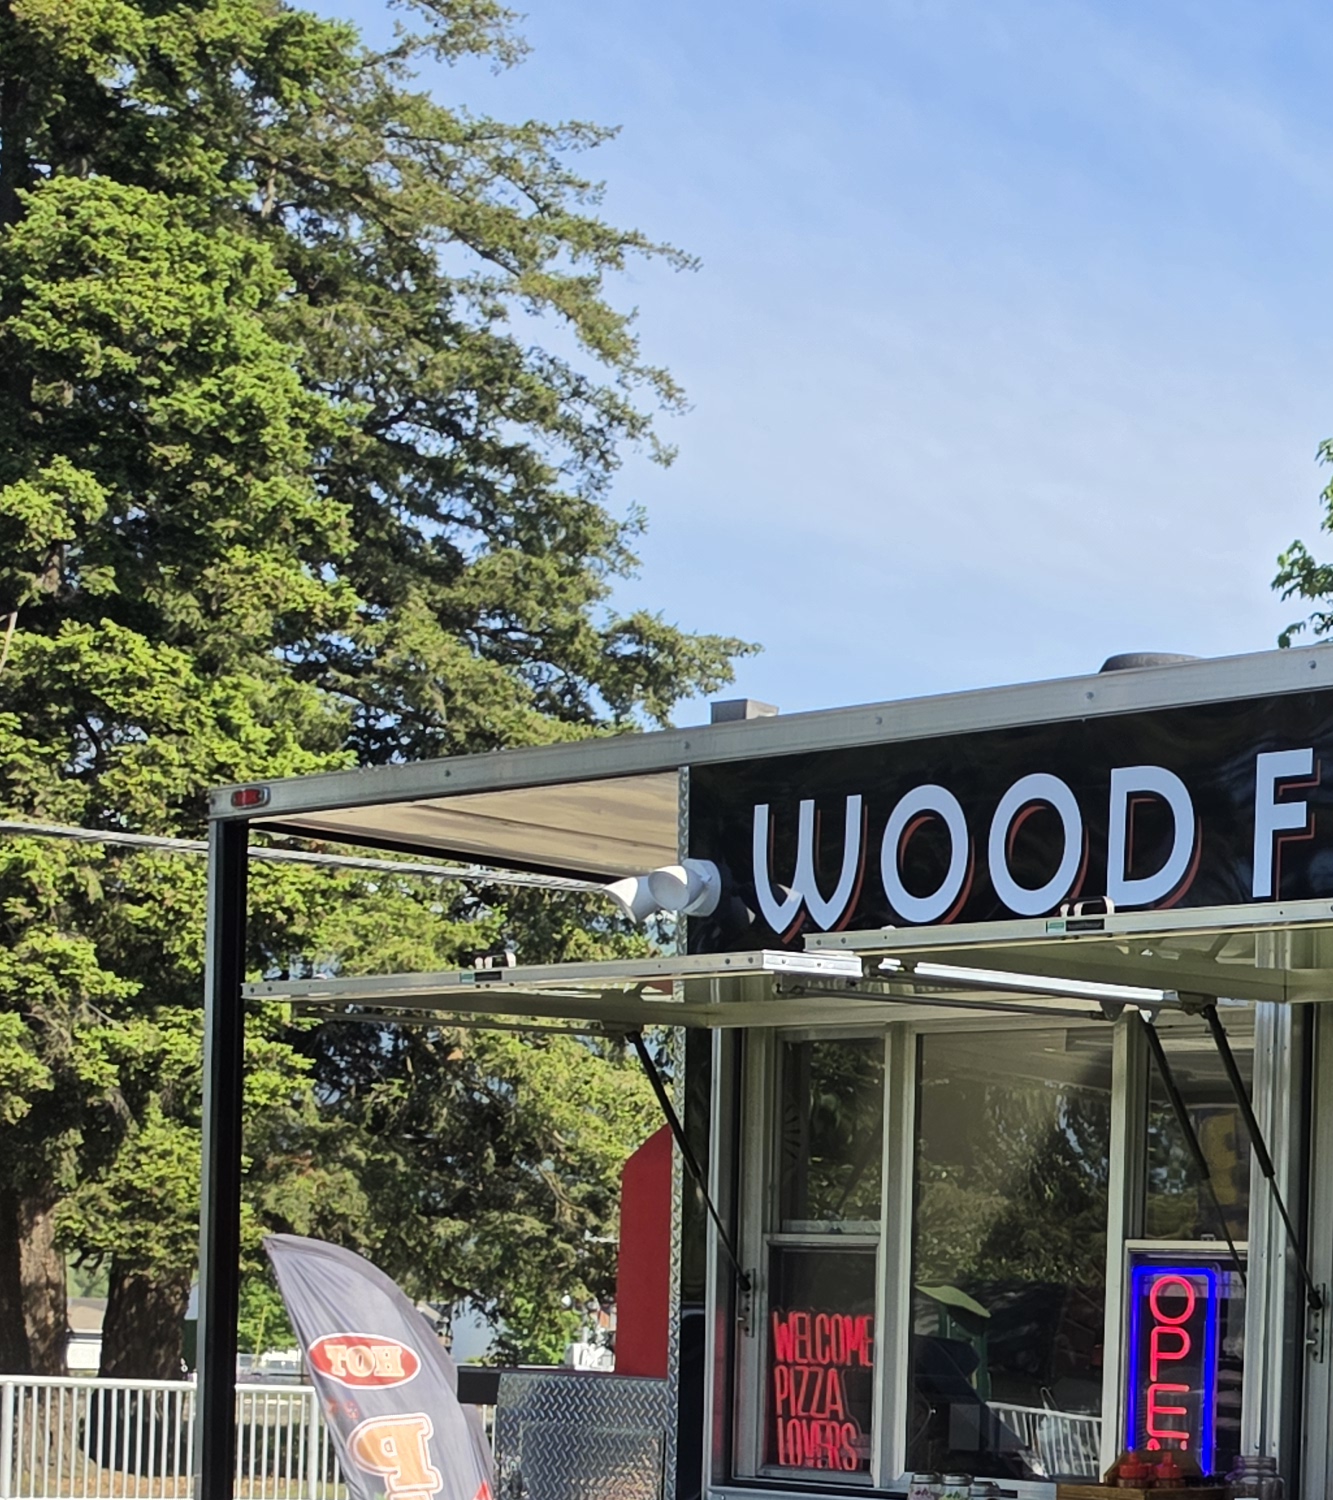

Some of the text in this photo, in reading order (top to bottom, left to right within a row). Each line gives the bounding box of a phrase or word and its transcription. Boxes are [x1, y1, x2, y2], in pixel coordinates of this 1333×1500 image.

[752, 764, 1202, 938] WOOD
[771, 1311, 875, 1367] WELCOME
[1146, 1274, 1197, 1452] OPE
[774, 1365, 846, 1420] PIZZA
[776, 1416, 860, 1472] LOVERS
